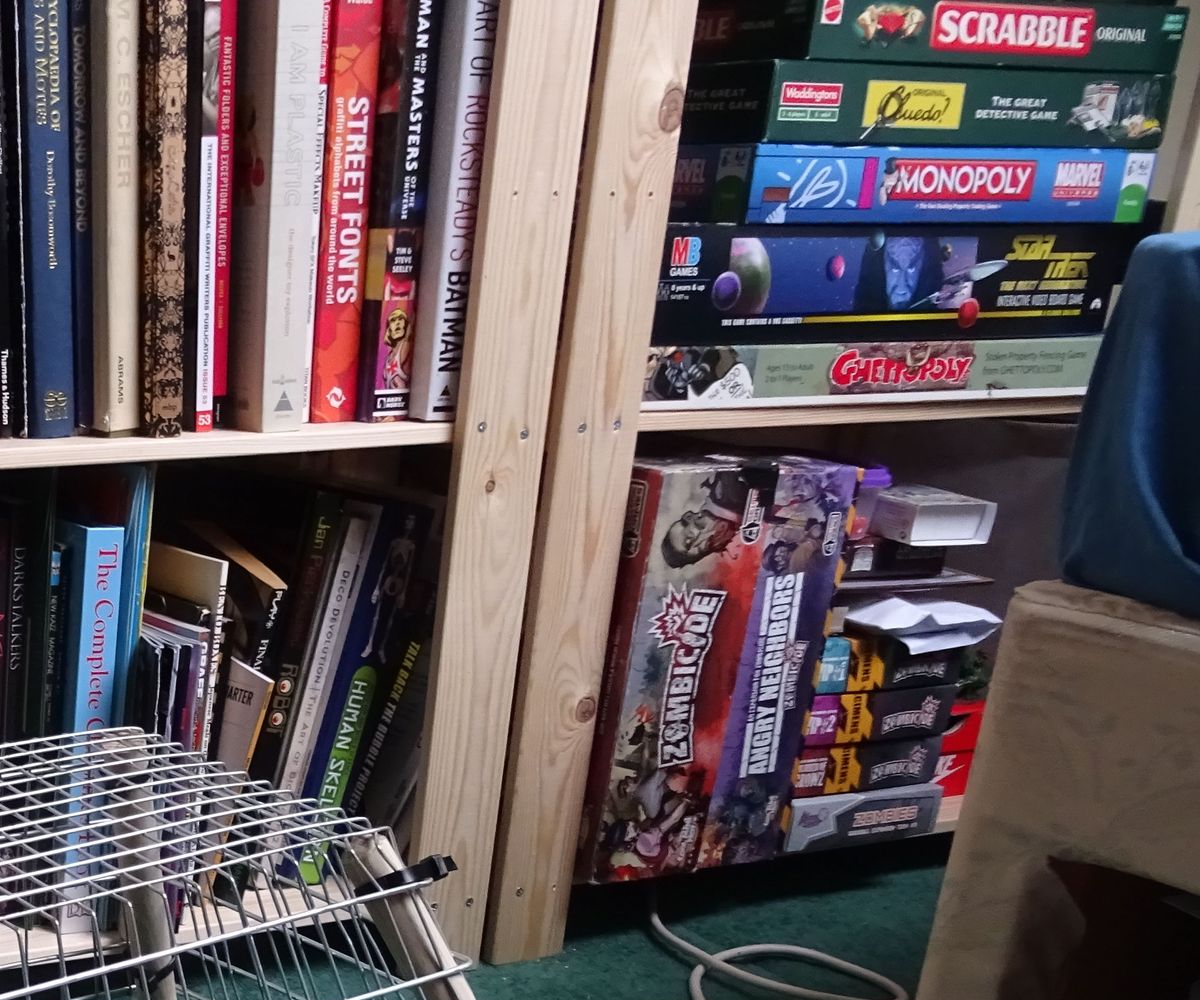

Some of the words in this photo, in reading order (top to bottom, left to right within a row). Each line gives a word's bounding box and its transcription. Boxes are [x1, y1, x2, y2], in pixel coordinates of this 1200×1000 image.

[937, 9, 1092, 49] SCRABBLE
[1095, 26, 1147, 42] ORIGINAL
[72, 25, 87, 123] TOMORROW
[221, 36, 233, 86] FANTASTIC
[469, 56, 494, 86] OF
[219, 90, 231, 130] FOLDERS
[316, 90, 326, 128] SPECIAL
[784, 86, 840, 102] Waddingtons
[991, 95, 1012, 108] THE
[1013, 96, 1048, 109] GREAT
[49, 110, 61, 132] OF
[117, 73, 133, 188] ESCHER
[334, 97, 344, 137] graffiti
[405, 77, 426, 172] MASTERS
[974, 107, 1027, 121] DETECTIVE
[1029, 108, 1060, 121] GAME
[73, 127, 87, 163] AND
[218, 133, 230, 152] AND
[283, 93, 306, 207] PLASTIC
[314, 133, 324, 171] EFFECTS
[341, 96, 371, 205] STREET
[43, 151, 57, 197] Dorothy
[331, 139, 343, 190] alphabets
[896, 163, 1033, 196] MONOPOLY
[1055, 162, 1105, 187] MARVEL
[74, 168, 89, 232] BEYOND
[205, 165, 214, 231] INTERNATIONAL
[217, 155, 230, 215] EXCEPTIONAL
[312, 175, 323, 215] MAKEUP
[401, 176, 411, 220] UNIVERSE
[329, 192, 341, 217] from
[215, 218, 228, 268] ENVELOPES
[326, 219, 339, 253] around
[670, 236, 703, 267] MB
[326, 255, 336, 272] the
[334, 211, 363, 305] FONTS
[394, 256, 413, 265] STEVE
[669, 266, 700, 278] GAMES
[203, 274, 211, 311] WRITERS
[324, 275, 335, 304] world
[202, 313, 210, 367] PUBLICATION
[437, 271, 471, 373] BATMAN
[0, 349, 9, 385] Thames
[116, 356, 125, 404] ABRAMS
[831, 349, 973, 386] GHETTOPOLY
[1, 394, 9, 425] Hudson
[198, 413, 211, 426] 53
[309, 515, 331, 550] Jan
[96, 543, 119, 591] The
[269, 589, 284, 621] PLAY
[334, 569, 351, 606] DECO
[9, 546, 27, 672] DARKSTALKERS
[86, 599, 115, 710] Complete
[313, 608, 341, 686] DEVOLUTION
[404, 640, 423, 665] TALK
[757, 573, 797, 701] NEIGHBORS
[389, 667, 412, 702] BACK
[659, 592, 724, 766] ZOMBICIDE
[304, 693, 318, 717] THE
[334, 678, 369, 752] HUMAN
[380, 702, 401, 723] THE
[296, 721, 310, 746] ART
[361, 724, 390, 765] BUBBLE
[749, 706, 777, 777] ANGRY
[347, 764, 374, 817] PROJECT
[852, 805, 920, 829] ZOMBIES
